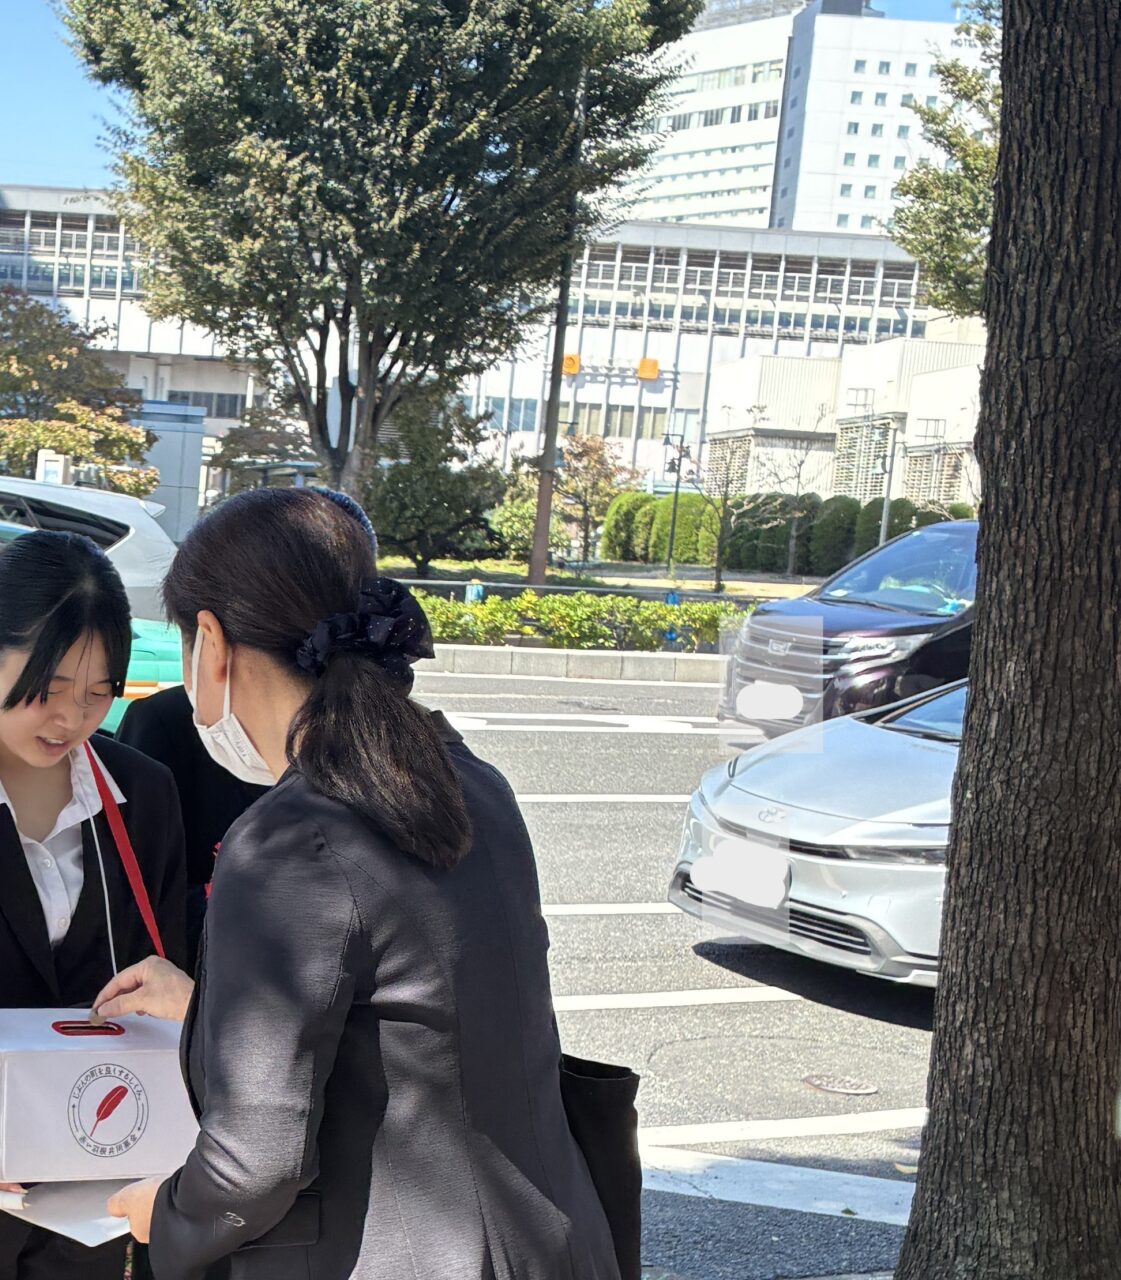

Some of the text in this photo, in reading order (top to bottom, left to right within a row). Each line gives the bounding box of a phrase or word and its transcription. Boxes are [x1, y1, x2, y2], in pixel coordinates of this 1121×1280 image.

[79, 1133, 138, 1156] 赤い羽根共同募金
